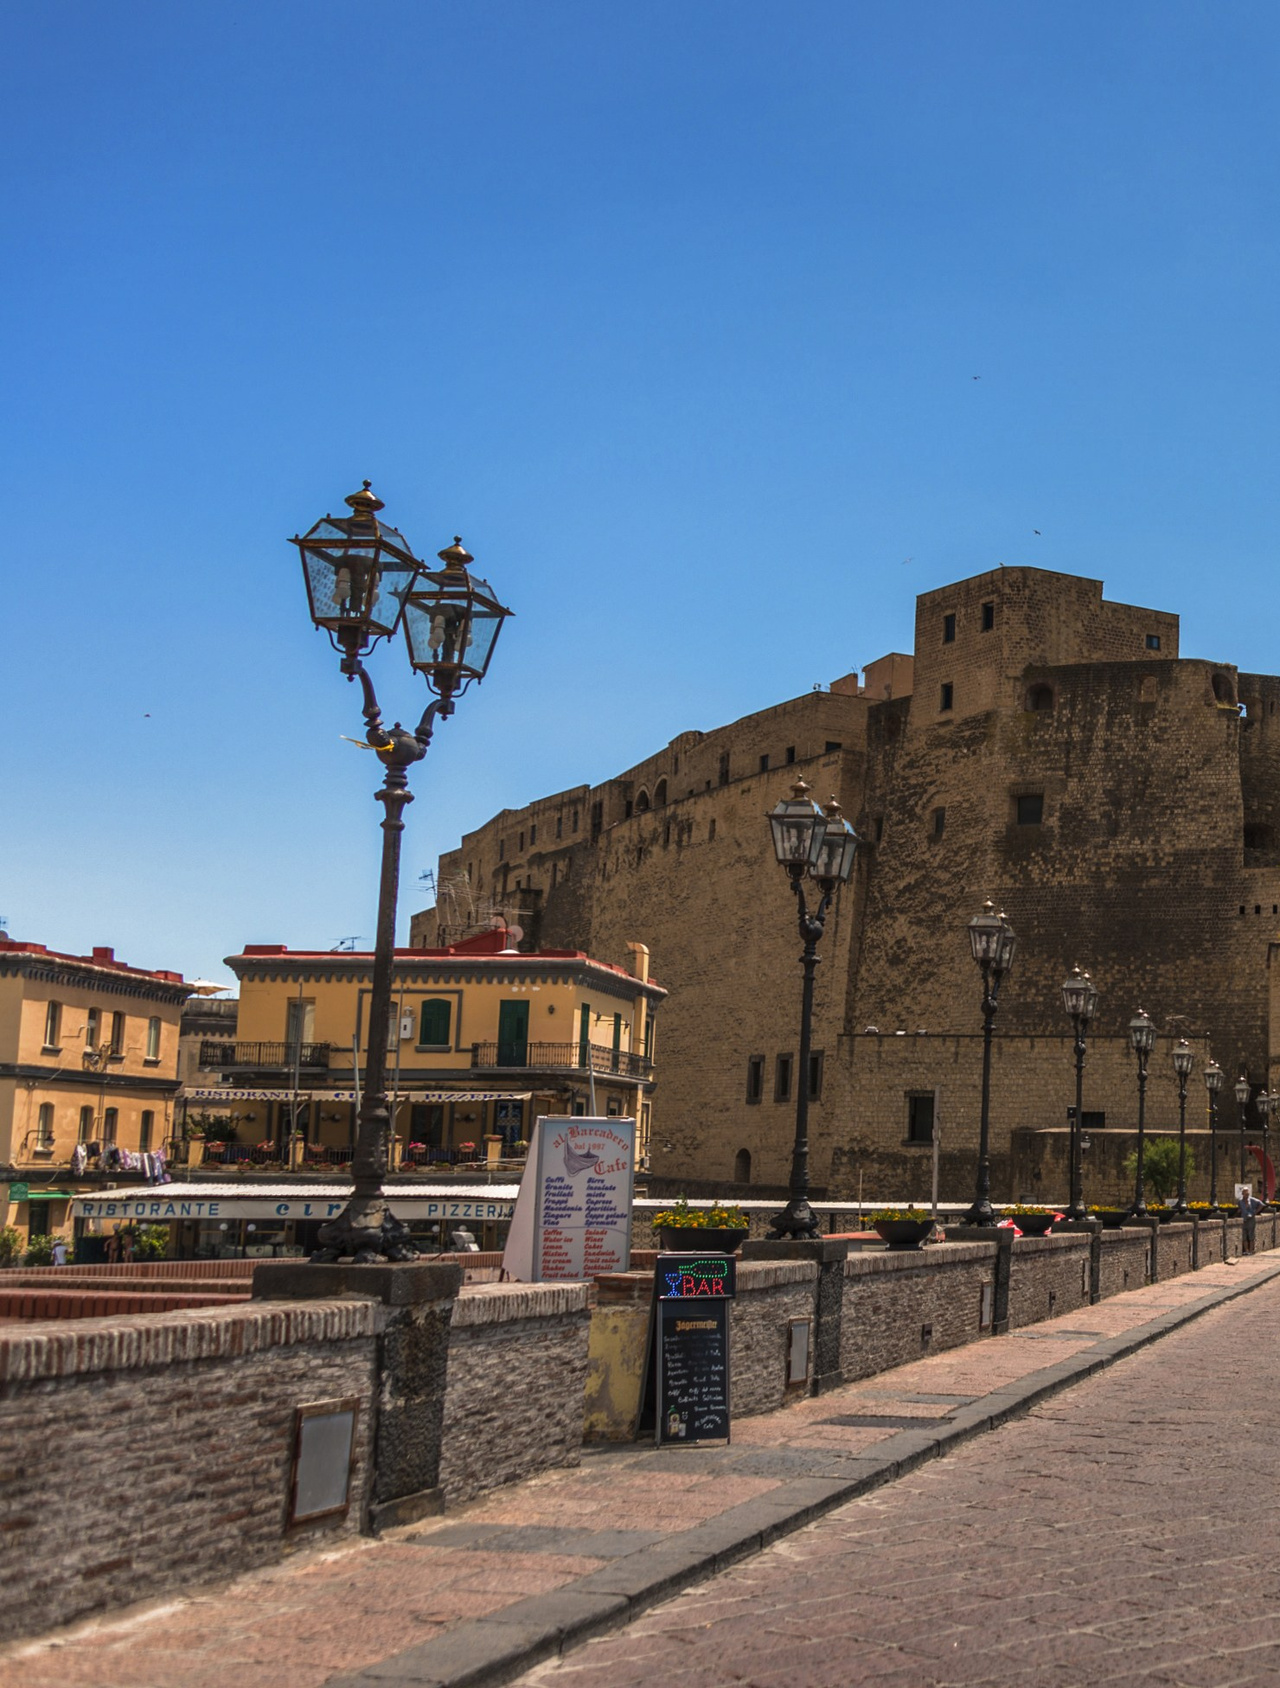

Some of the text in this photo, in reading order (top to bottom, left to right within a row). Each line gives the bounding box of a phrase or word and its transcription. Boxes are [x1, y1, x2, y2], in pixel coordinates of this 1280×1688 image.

[567, 1124, 629, 1151] Barcadero
[83, 1203, 219, 1216] RISTORANTE
[683, 1275, 725, 1296] BAR
